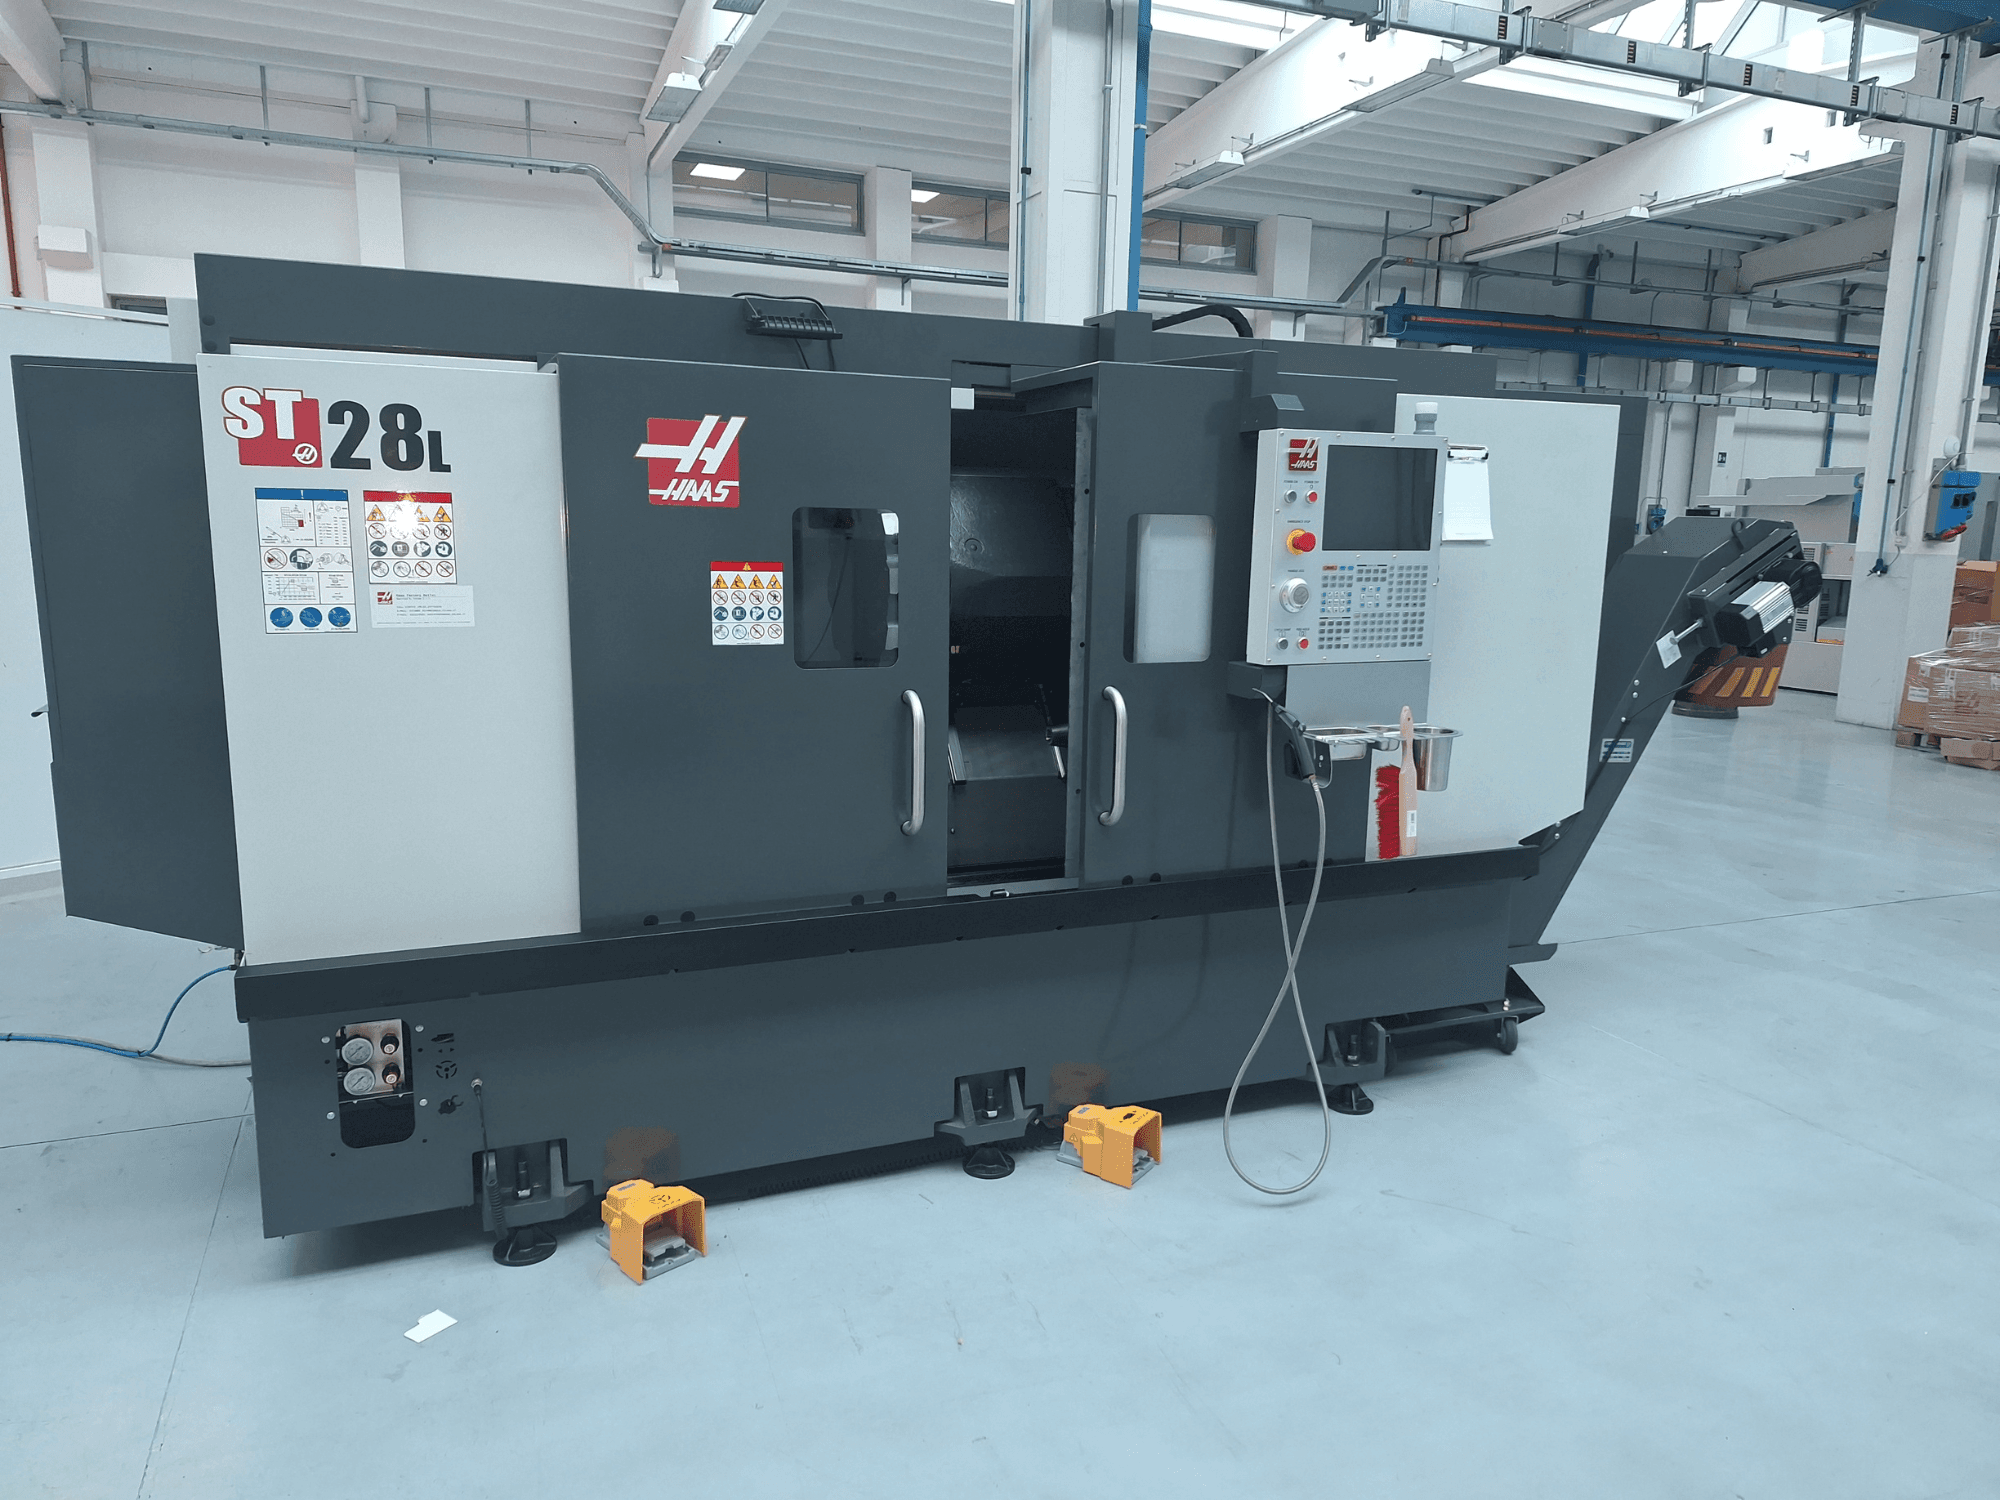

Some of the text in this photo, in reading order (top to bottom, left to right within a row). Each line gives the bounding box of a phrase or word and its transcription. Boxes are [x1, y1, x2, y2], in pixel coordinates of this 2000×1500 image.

[222, 385, 304, 441] ST
[1290, 459, 1318, 469] HAAS
[648, 478, 740, 503] HAAS
